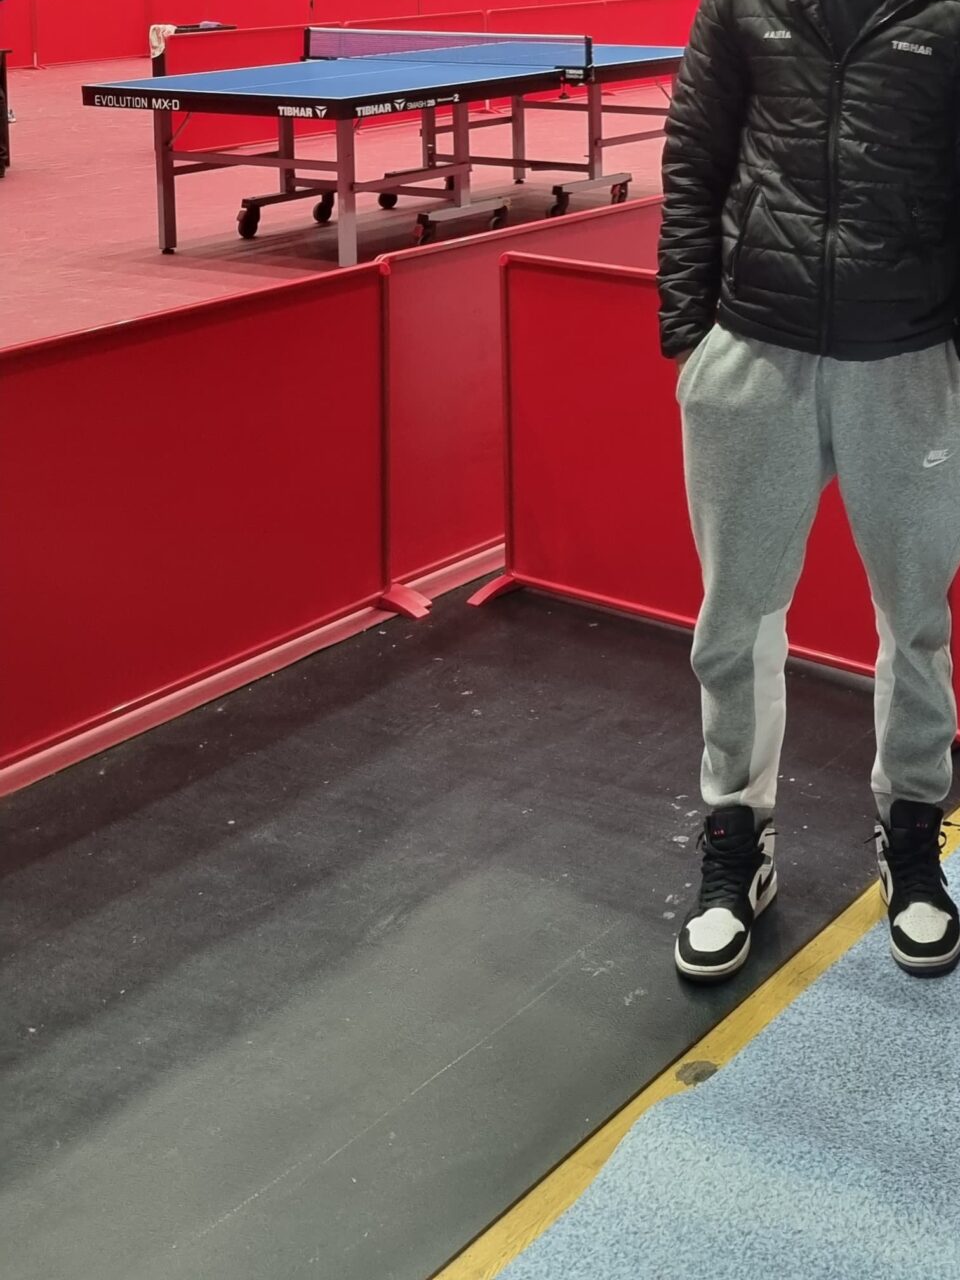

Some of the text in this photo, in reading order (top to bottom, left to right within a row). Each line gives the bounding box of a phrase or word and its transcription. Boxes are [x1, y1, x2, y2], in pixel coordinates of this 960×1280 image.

[891, 40, 932, 55] TIBHAR
[94, 95, 180, 111] EVOLUTION MX-D
[355, 102, 392, 117] TIBHAR
[407, 100, 427, 110] SMASH
[278, 105, 313, 118] TIBHAR
